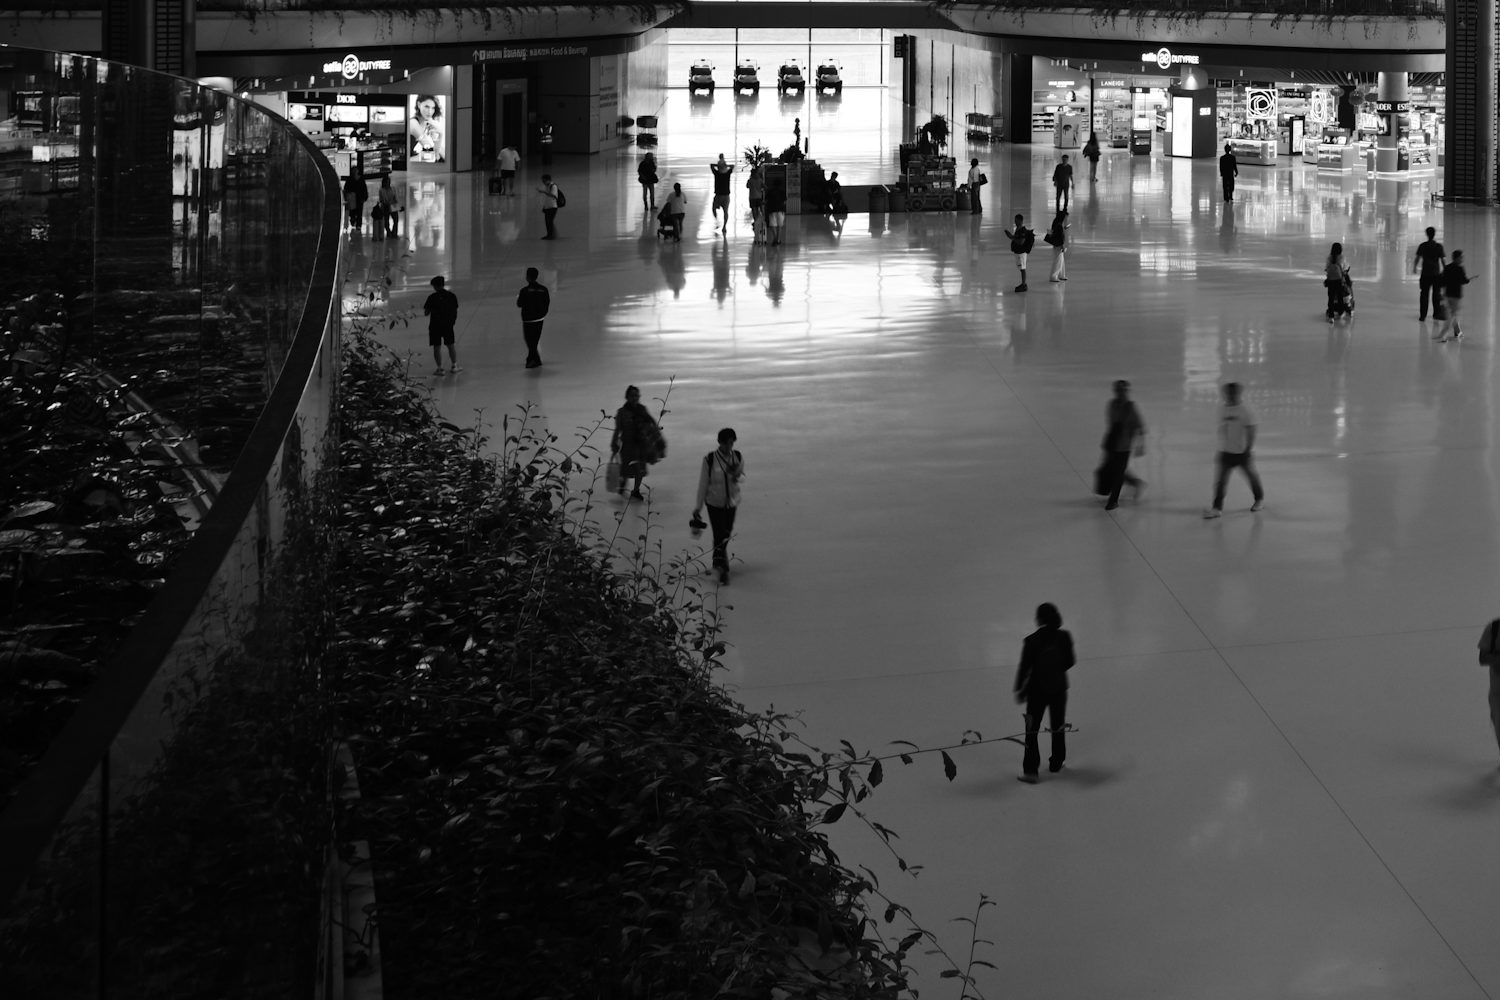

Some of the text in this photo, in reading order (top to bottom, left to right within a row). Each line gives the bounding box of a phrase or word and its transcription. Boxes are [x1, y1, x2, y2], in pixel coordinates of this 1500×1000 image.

[550, 47, 563, 56] Food
[1171, 55, 1200, 64] DUTYFREE
[359, 60, 391, 71] DUTYFREE
[336, 94, 357, 104] DIOR
